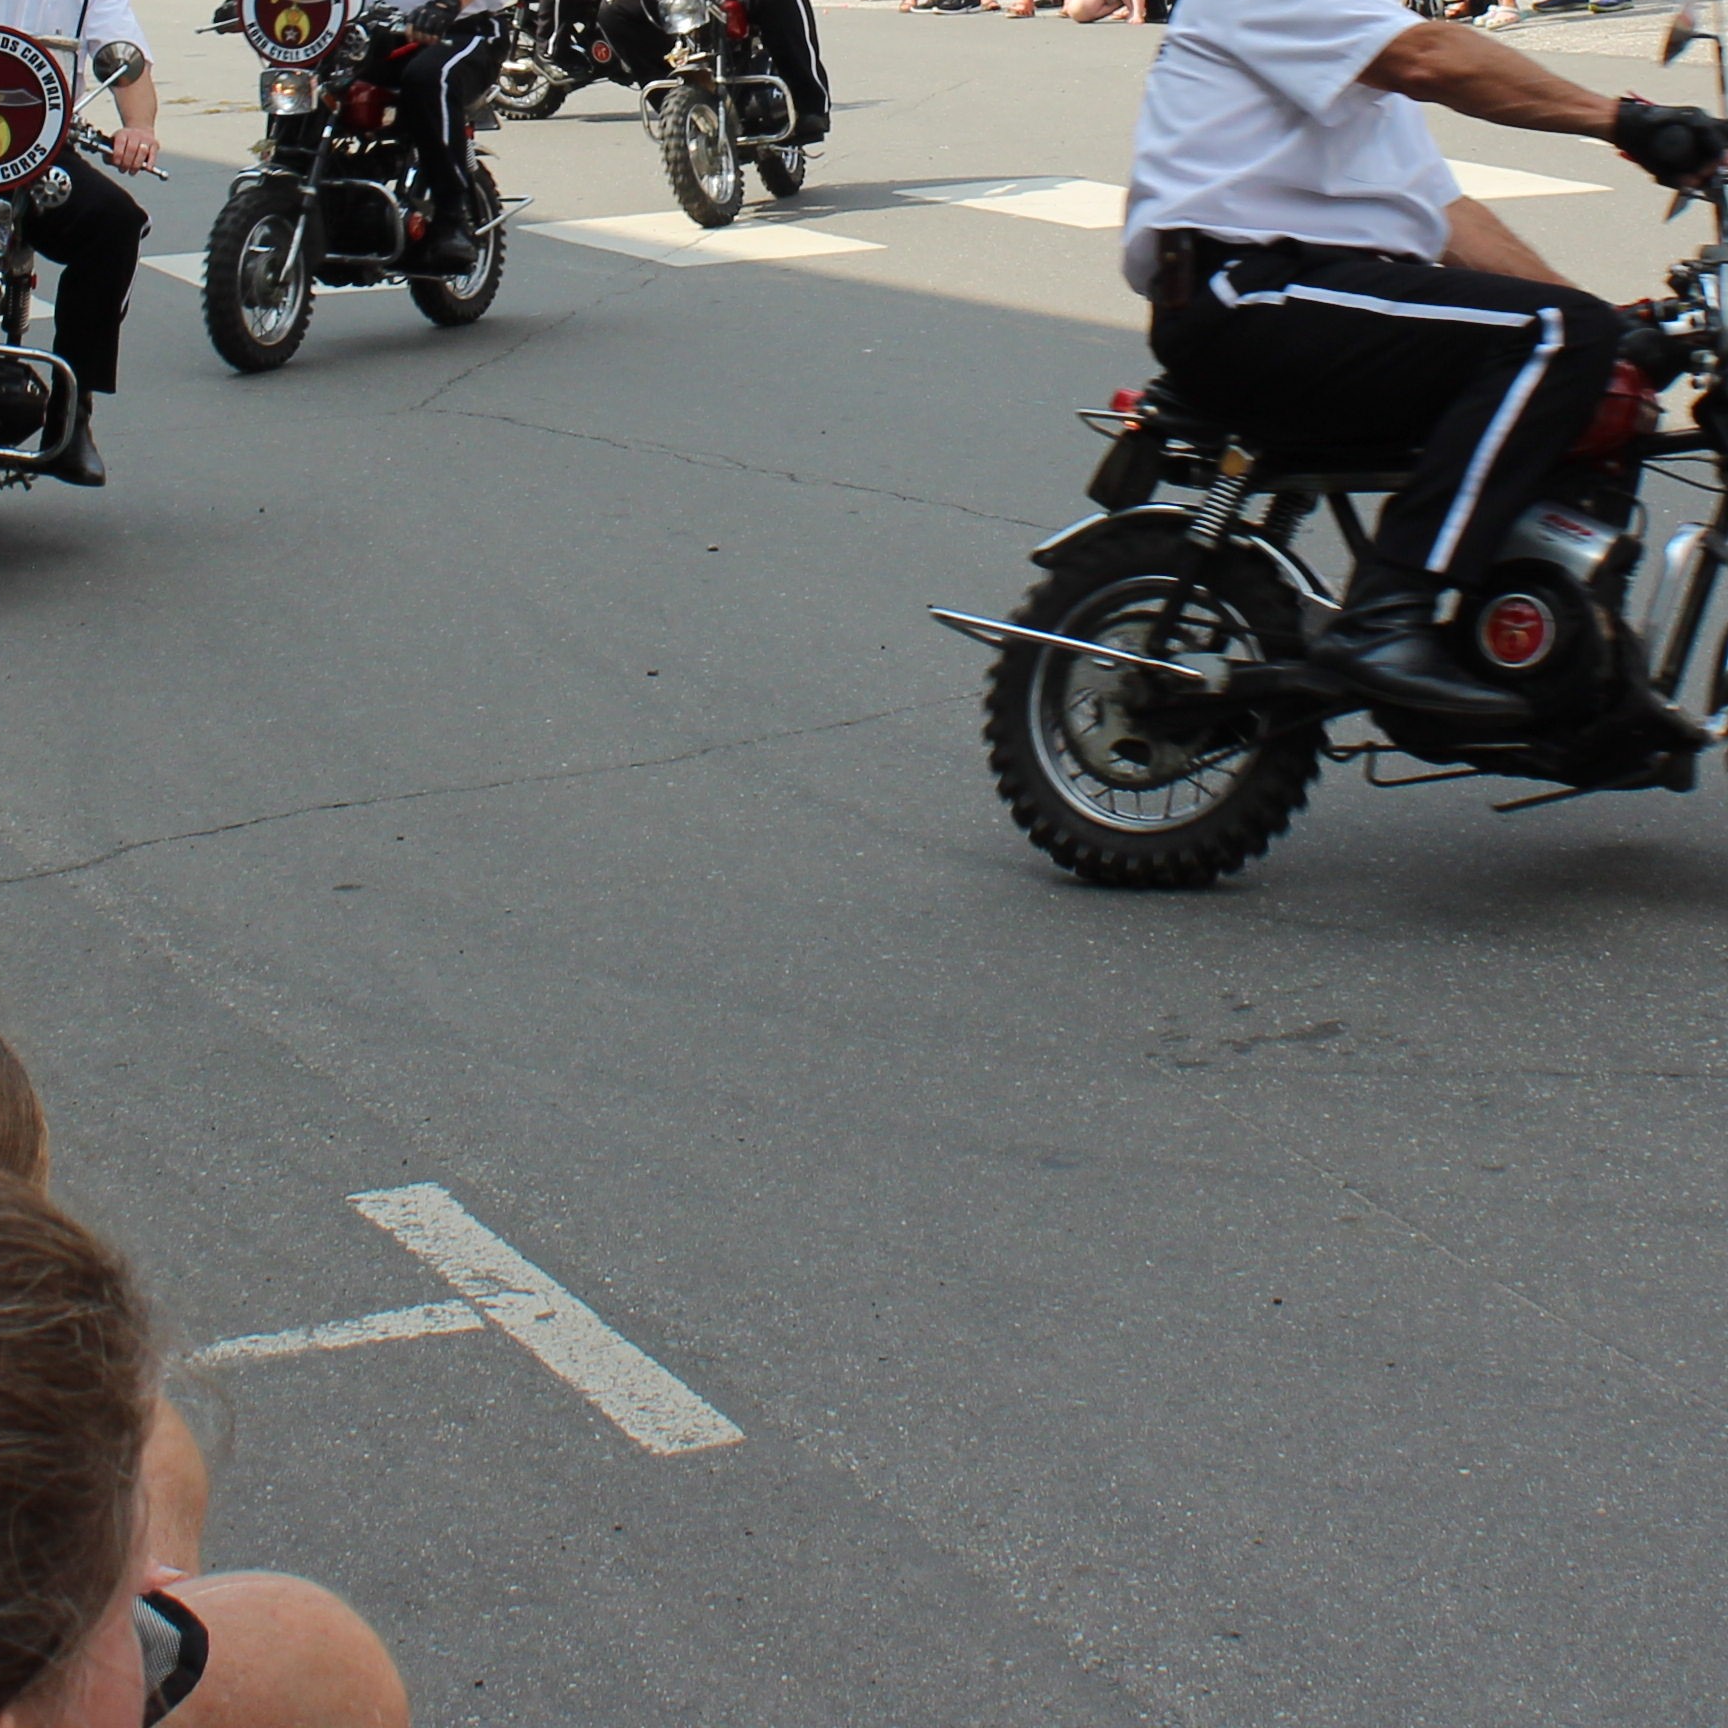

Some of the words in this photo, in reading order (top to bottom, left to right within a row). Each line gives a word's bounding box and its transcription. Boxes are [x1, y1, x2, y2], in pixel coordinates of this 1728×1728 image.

[269, 45, 301, 61] CYCLE
[20, 47, 48, 73] CAN
[40, 71, 62, 112] WALK
[0, 142, 48, 181] CORPS
